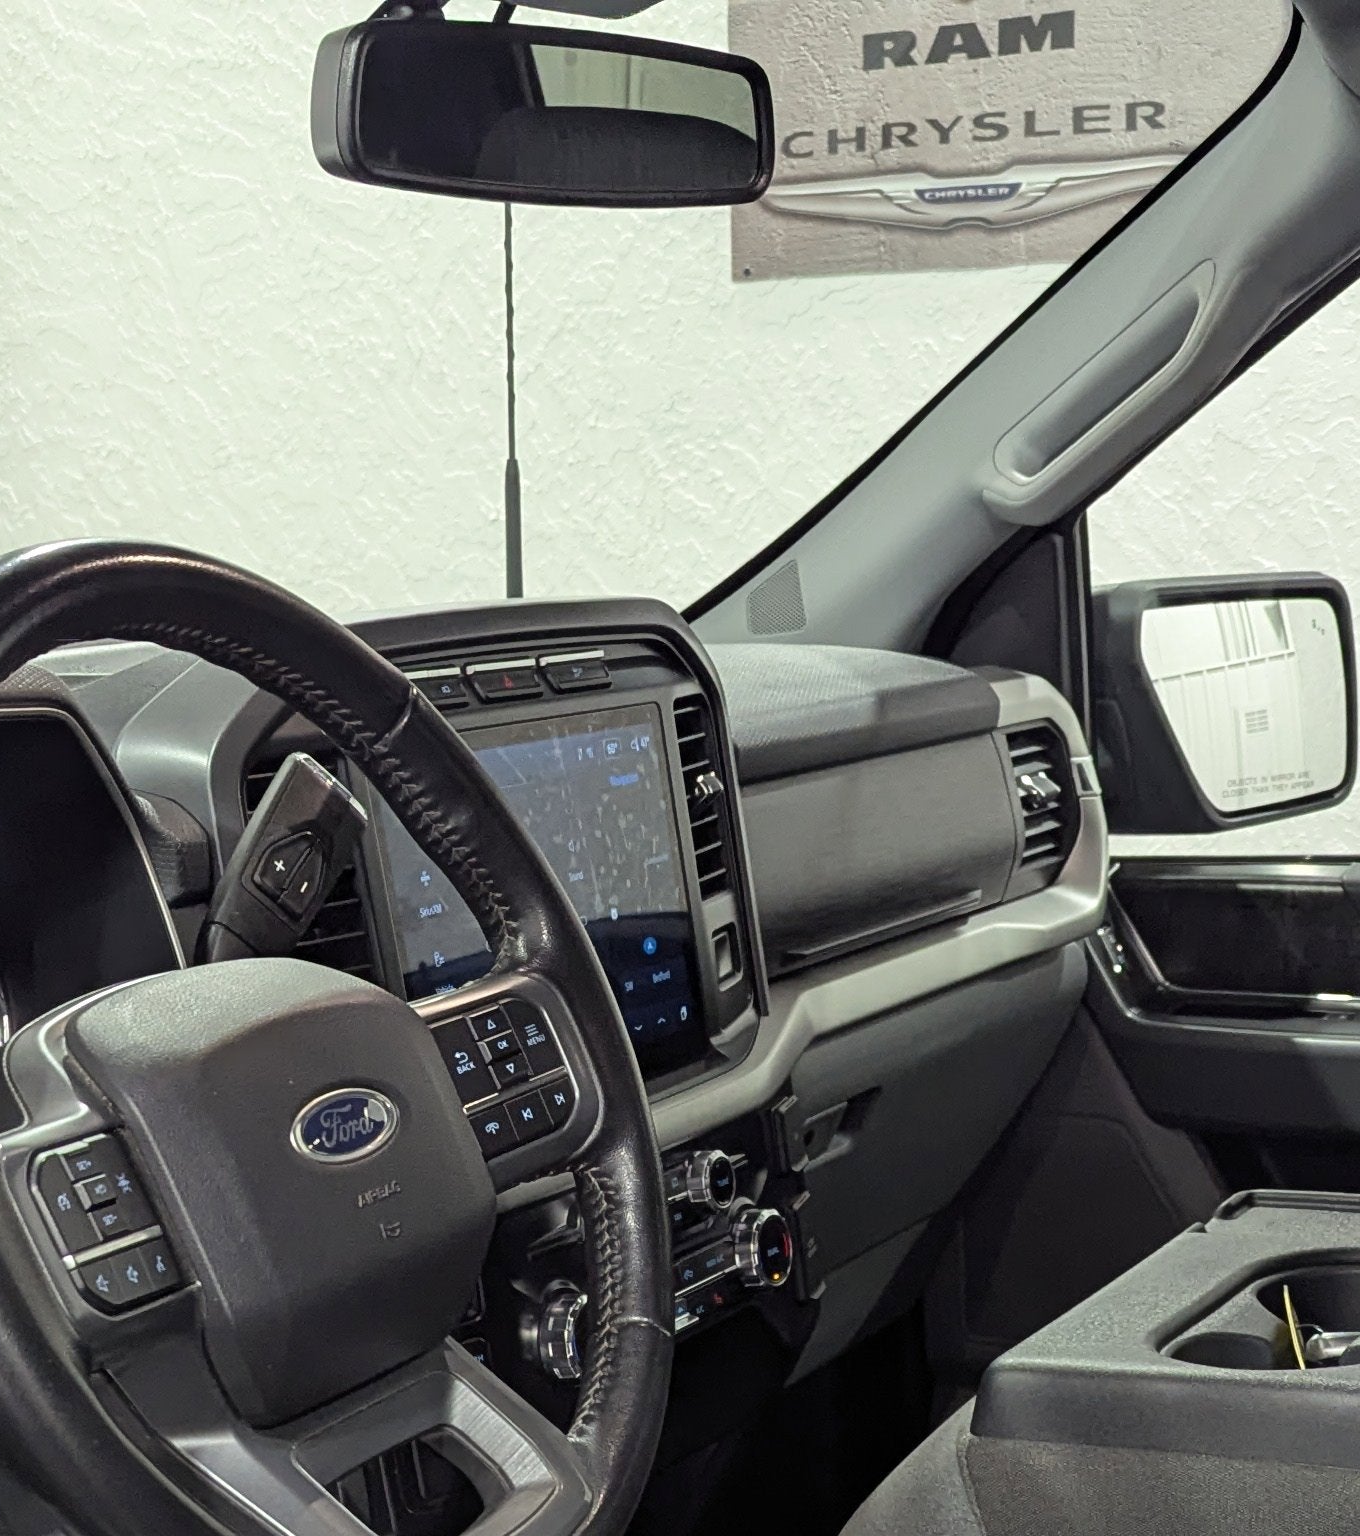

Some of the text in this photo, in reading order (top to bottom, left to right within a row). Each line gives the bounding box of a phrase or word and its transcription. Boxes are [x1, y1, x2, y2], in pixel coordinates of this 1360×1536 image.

[861, 10, 1075, 70] RAM
[781, 100, 1167, 160] CHRYSLER
[924, 187, 1010, 200] CHRYSLER
[497, 1039, 509, 1050] OK
[526, 1034, 546, 1047] MENU
[456, 1060, 476, 1075] BACK
[320, 1104, 374, 1148] Ford
